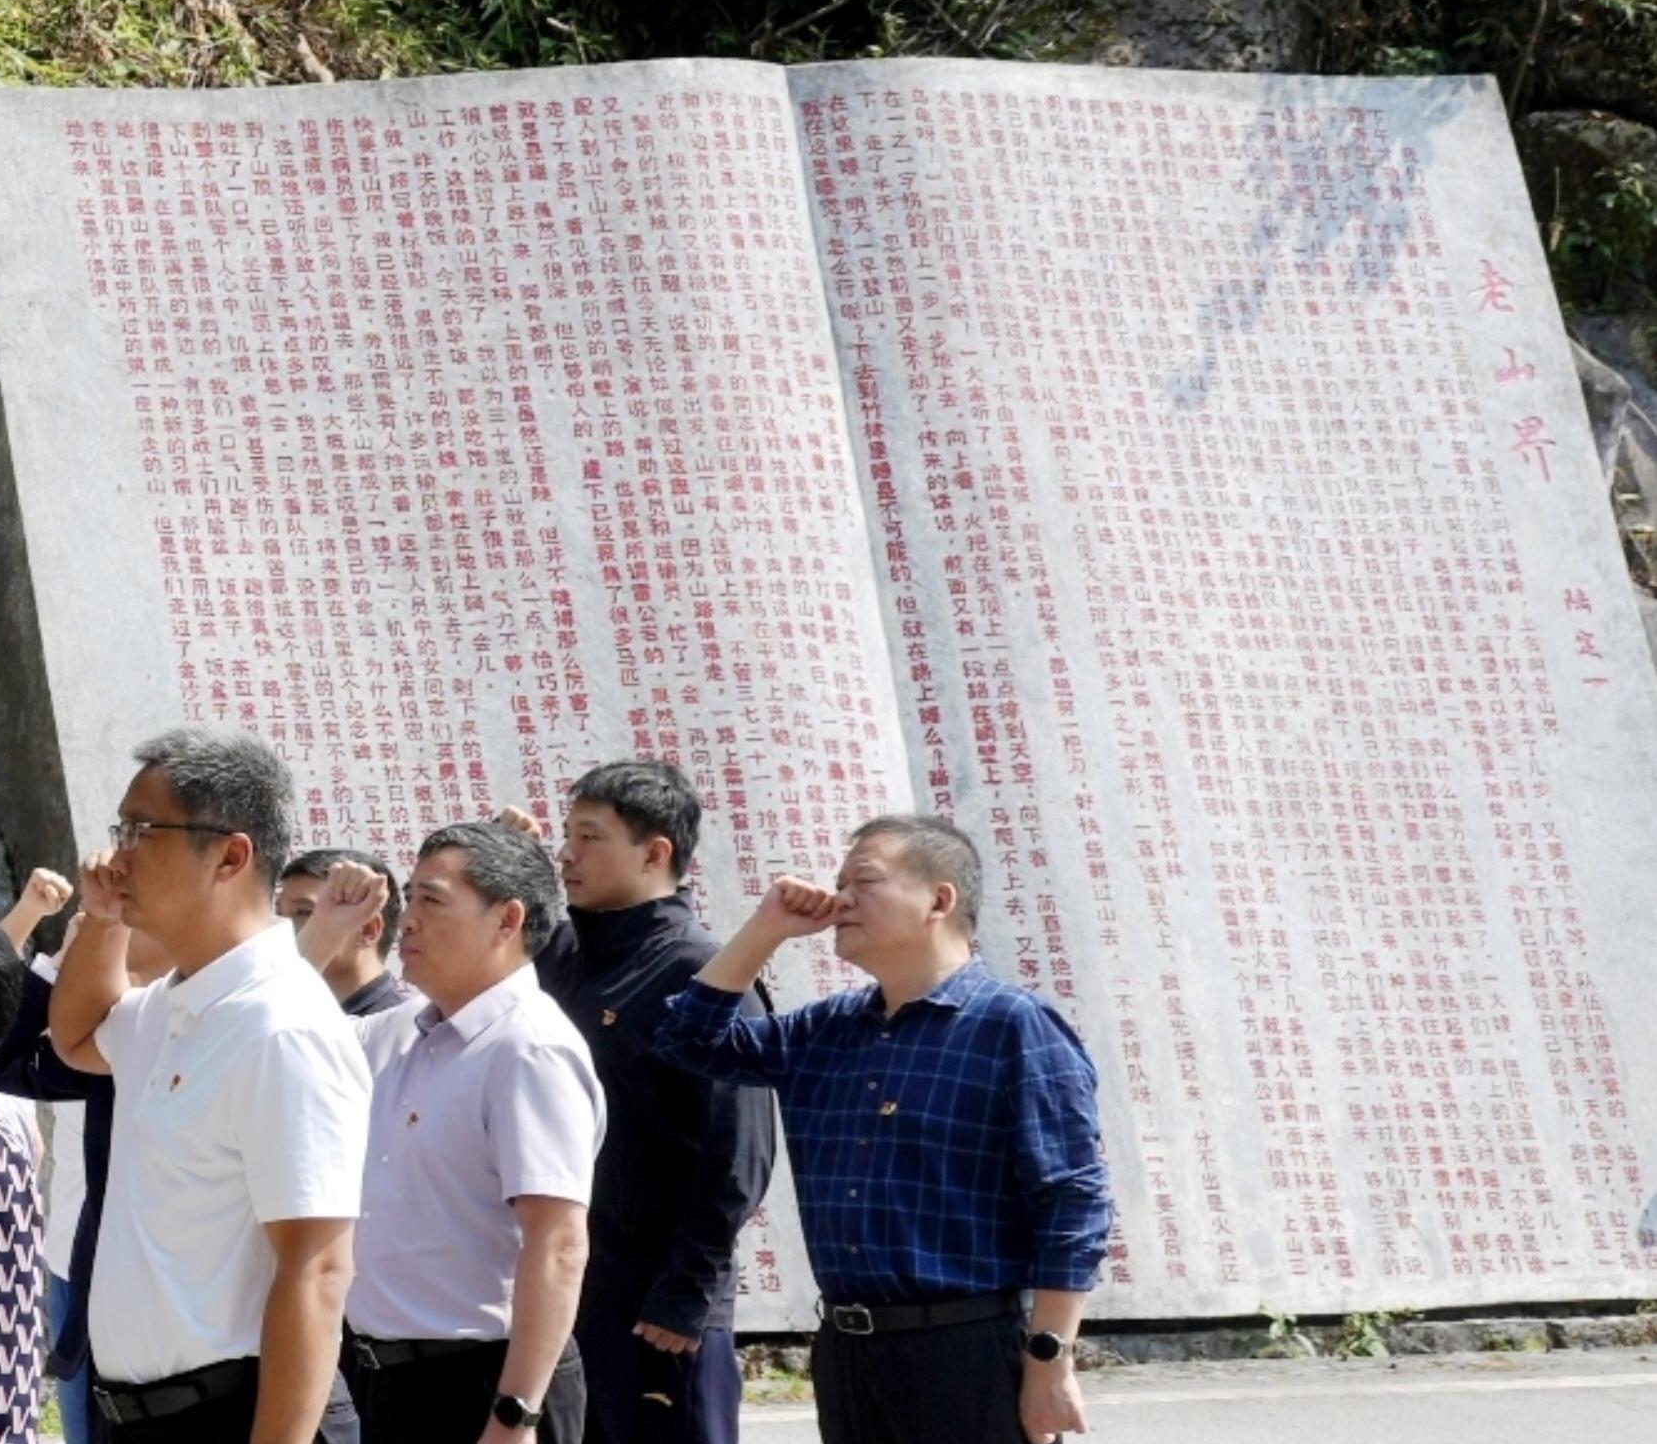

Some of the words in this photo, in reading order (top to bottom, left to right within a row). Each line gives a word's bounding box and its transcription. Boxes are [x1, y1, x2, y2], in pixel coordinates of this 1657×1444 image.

[1471, 259, 1554, 483] 老山界
[1564, 588, 1608, 686] 陆定一
